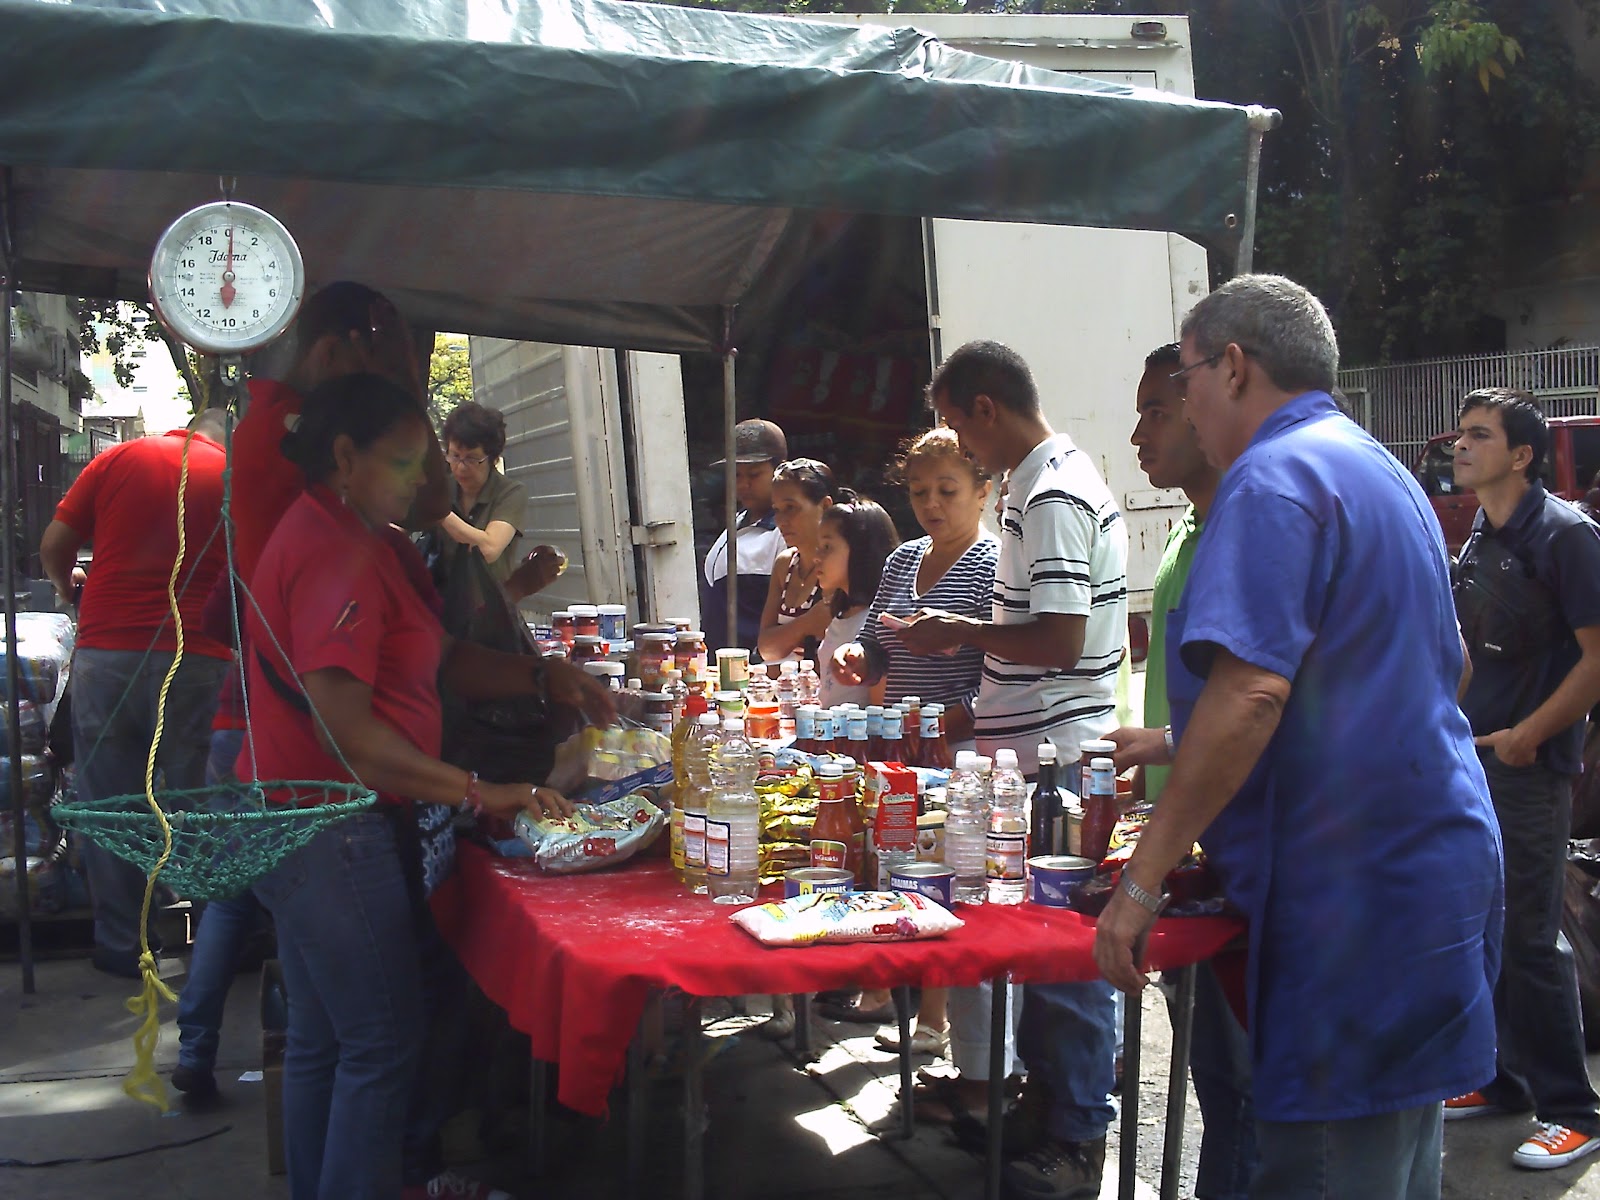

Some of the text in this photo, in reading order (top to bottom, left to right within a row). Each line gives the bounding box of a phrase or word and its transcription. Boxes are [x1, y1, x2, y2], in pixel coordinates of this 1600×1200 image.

[224, 228, 232, 238] 0
[198, 236, 213, 246] 18
[251, 237, 258, 246] 2
[181, 259, 195, 268] 16
[268, 260, 276, 269] 4
[180, 287, 195, 297] 14
[269, 288, 276, 298] 6
[196, 309, 211, 318] 12
[252, 309, 260, 319] 8
[221, 318, 236, 327] 10
